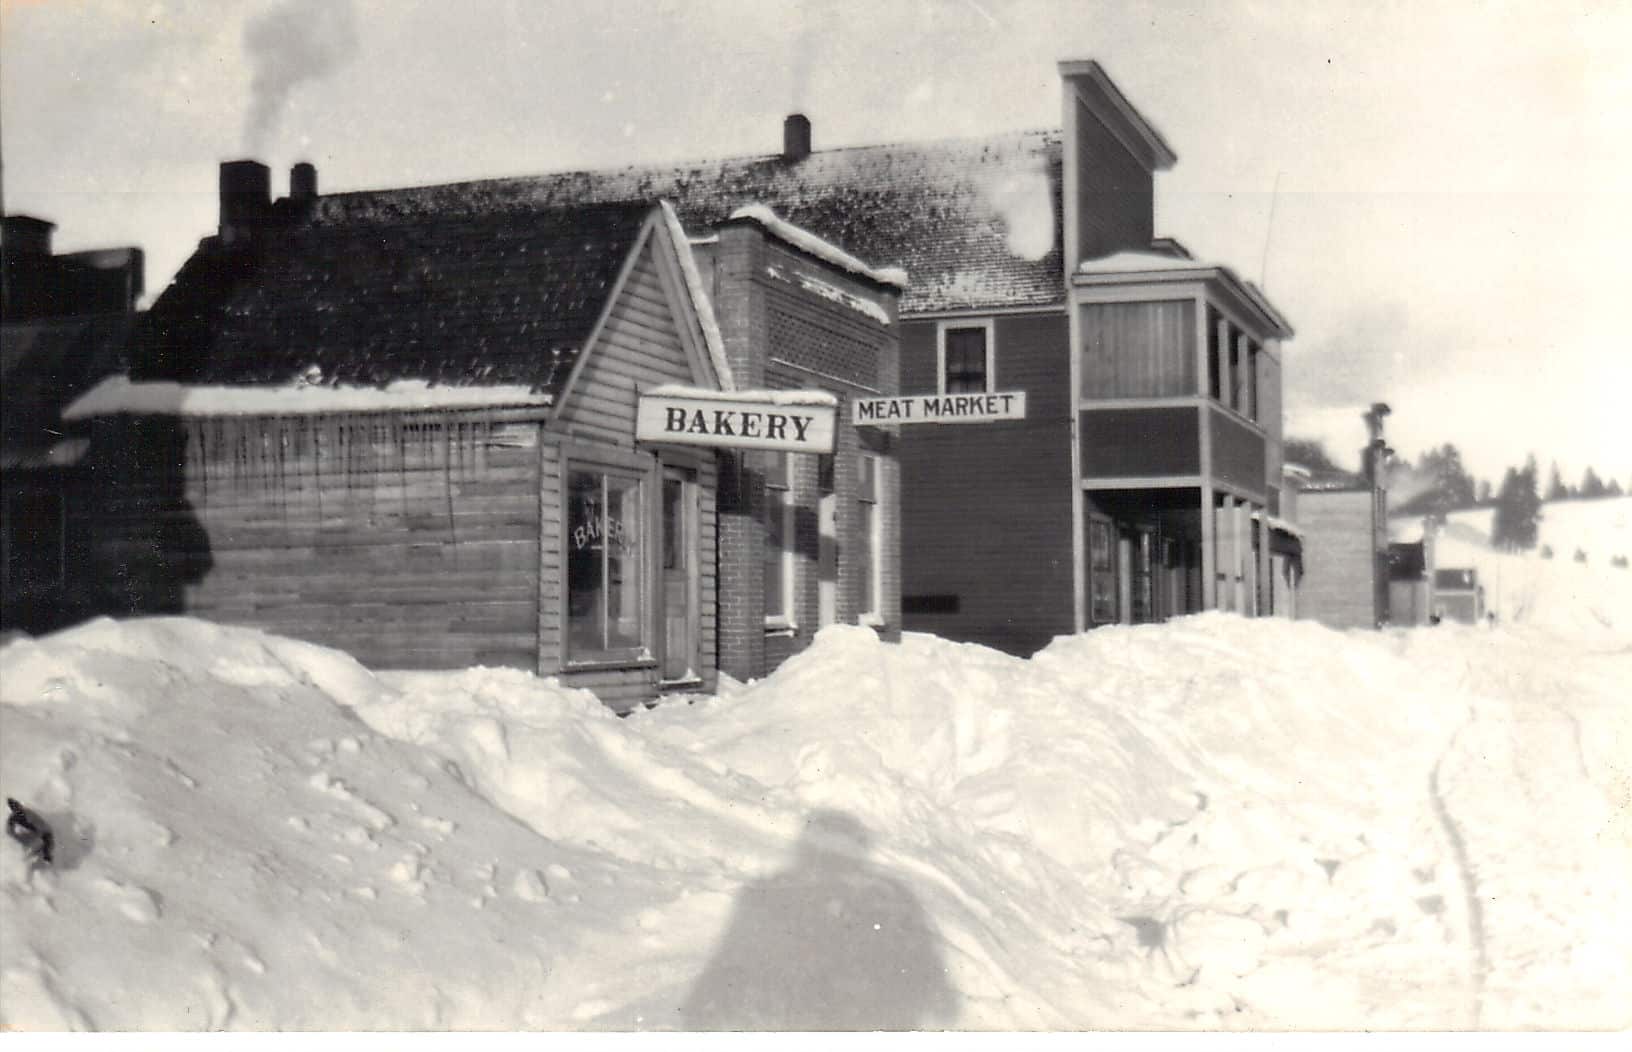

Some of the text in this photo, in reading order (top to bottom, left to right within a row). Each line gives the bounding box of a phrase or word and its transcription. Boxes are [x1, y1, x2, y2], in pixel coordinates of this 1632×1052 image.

[665, 407, 814, 442] BAKERY
[858, 395, 1014, 420] MEAT MARKET
[573, 514, 632, 553] BAKER
